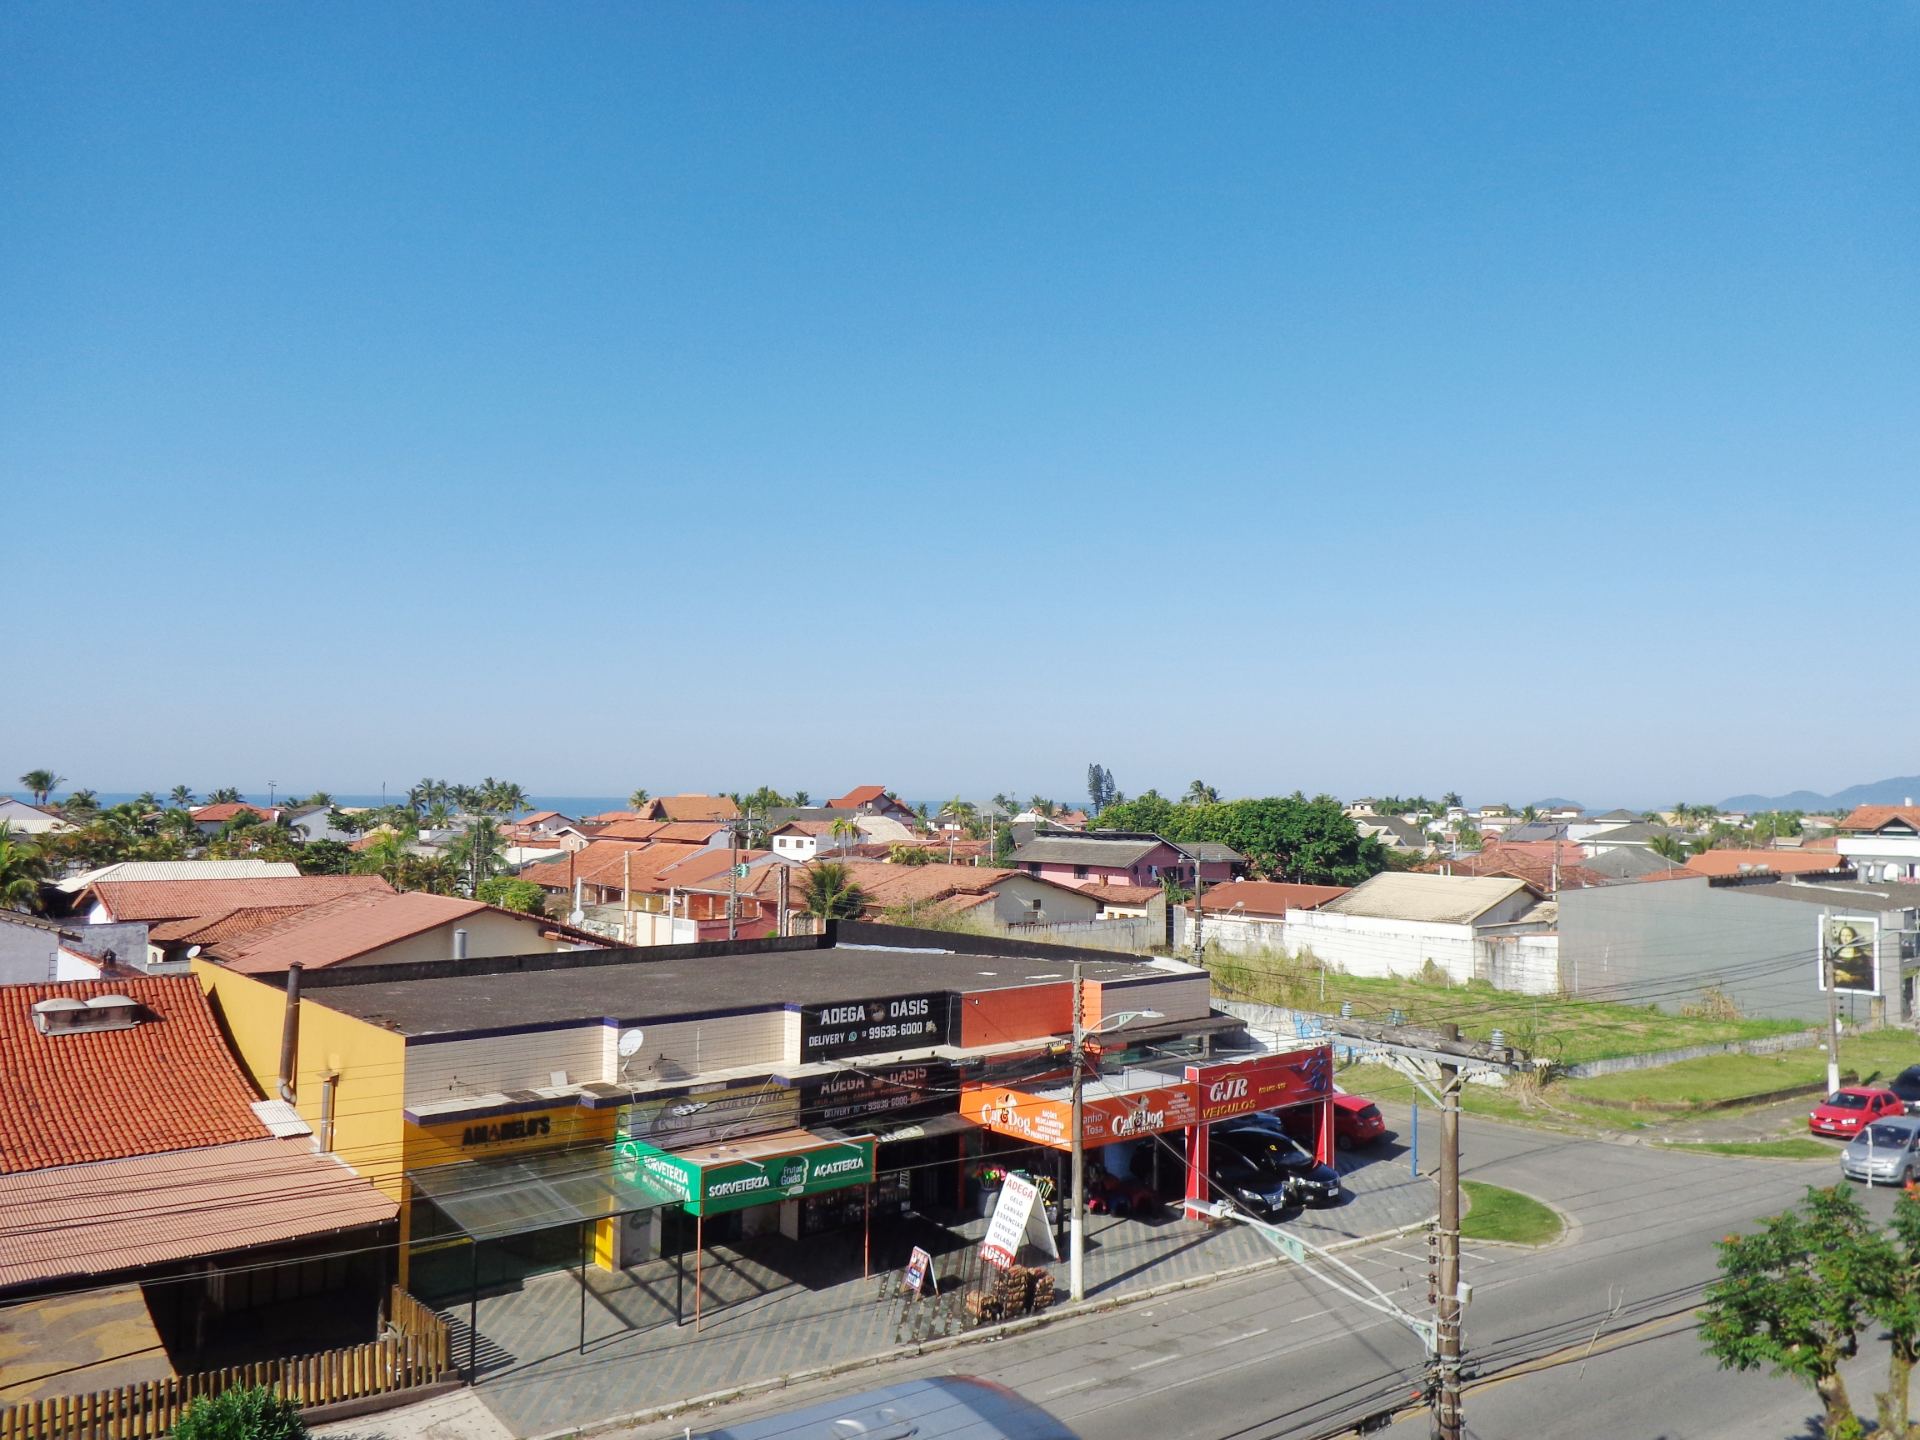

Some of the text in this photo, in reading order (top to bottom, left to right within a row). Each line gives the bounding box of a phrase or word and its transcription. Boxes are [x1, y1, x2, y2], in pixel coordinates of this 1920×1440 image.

[820, 1005, 866, 1026] ADEGA
[808, 1033, 845, 1047] DELIVERY
[1209, 1078, 1249, 1102] GJR
[1082, 1112, 1103, 1124] anho
[1202, 1099, 1257, 1119] VEICULOS
[1008, 1107, 1031, 1136] Dog
[708, 1175, 770, 1198] SORVETERIA
[1006, 1179, 1033, 1200] ADEGA
[1009, 1195, 1023, 1207] GELO
